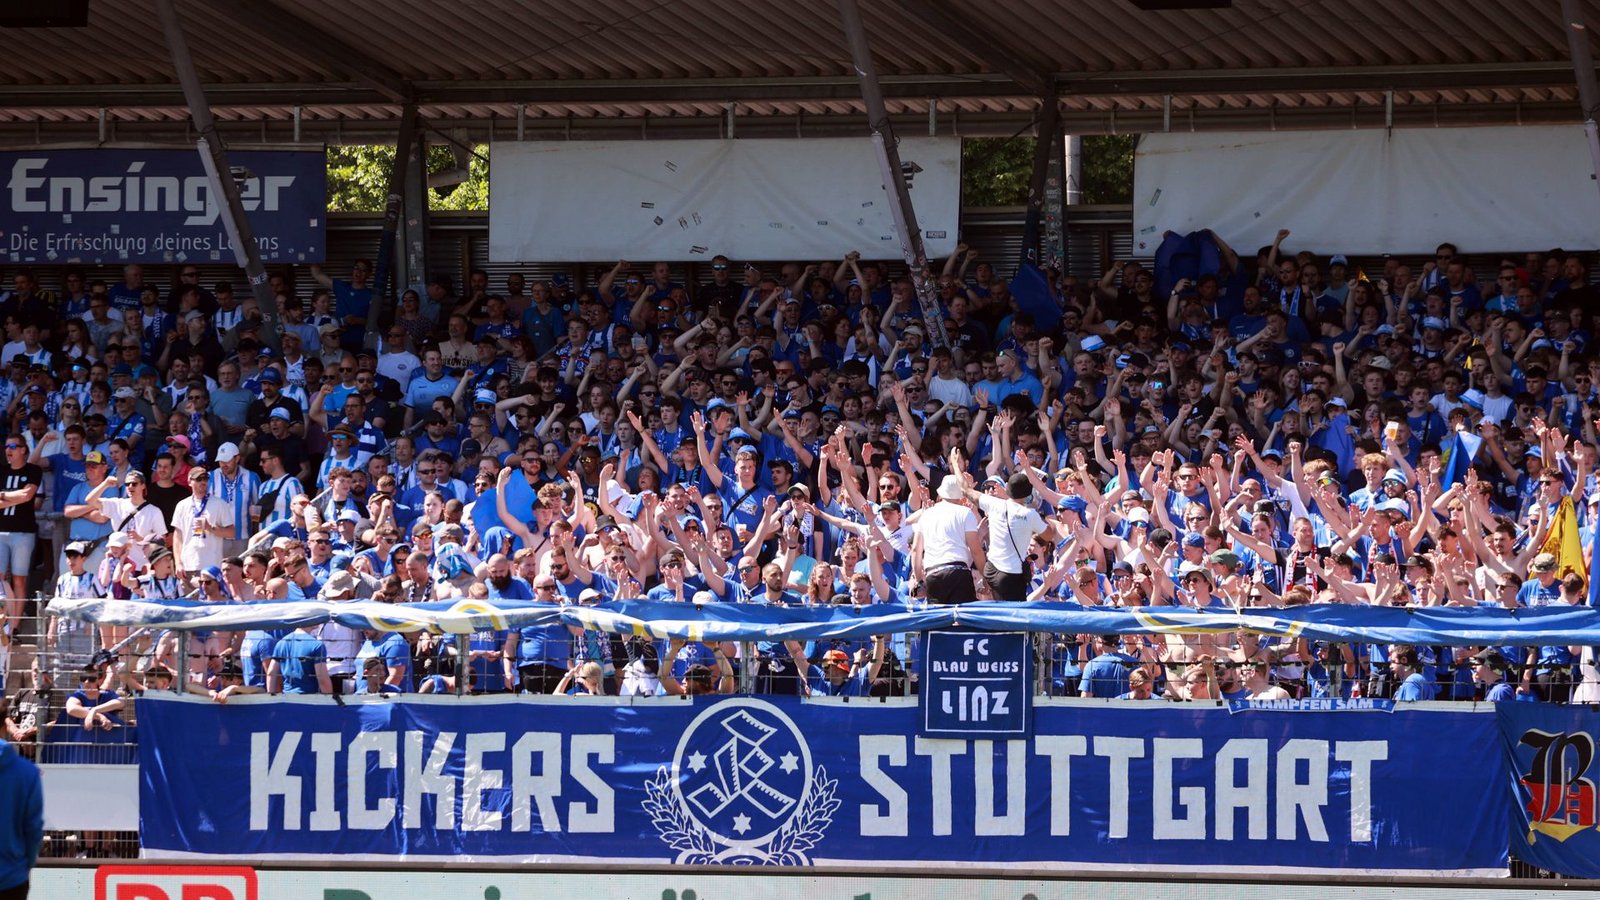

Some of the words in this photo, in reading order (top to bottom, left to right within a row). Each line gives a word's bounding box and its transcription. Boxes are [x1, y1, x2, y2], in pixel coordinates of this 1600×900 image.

[7, 159, 295, 227] Ensinger
[11, 233, 38, 250] Die
[46, 232, 146, 255] Erfrischung
[155, 232, 211, 250] deines
[219, 232, 279, 250] Lns
[963, 638, 989, 656] FC
[932, 660, 969, 673] BLAU
[977, 661, 1019, 673] WEISS
[941, 685, 1010, 722] LINZ
[250, 731, 615, 833] KICKERS
[859, 735, 1388, 843] STUTTGART
